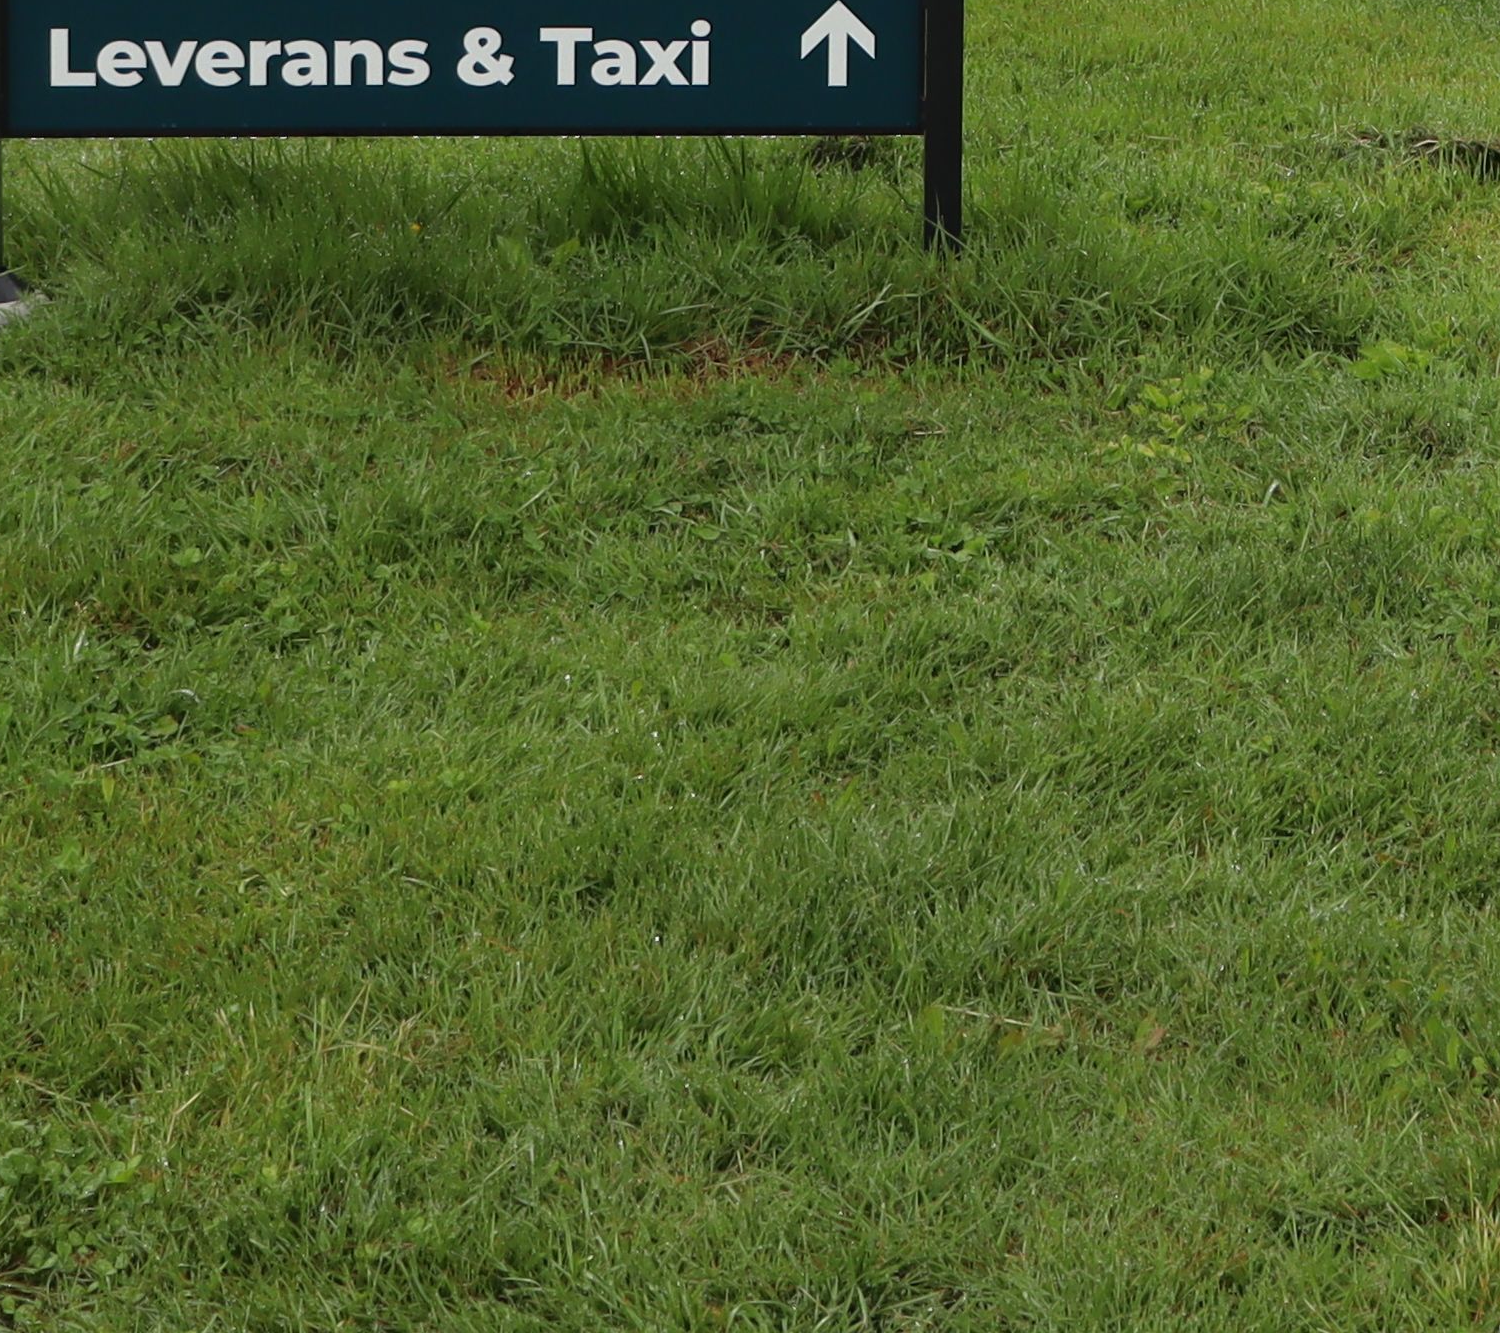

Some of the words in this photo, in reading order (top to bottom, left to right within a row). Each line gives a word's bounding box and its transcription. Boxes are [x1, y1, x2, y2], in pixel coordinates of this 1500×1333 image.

[50, 28, 430, 87] Leverans
[457, 26, 515, 87] &
[540, 19, 711, 87] Taxi
